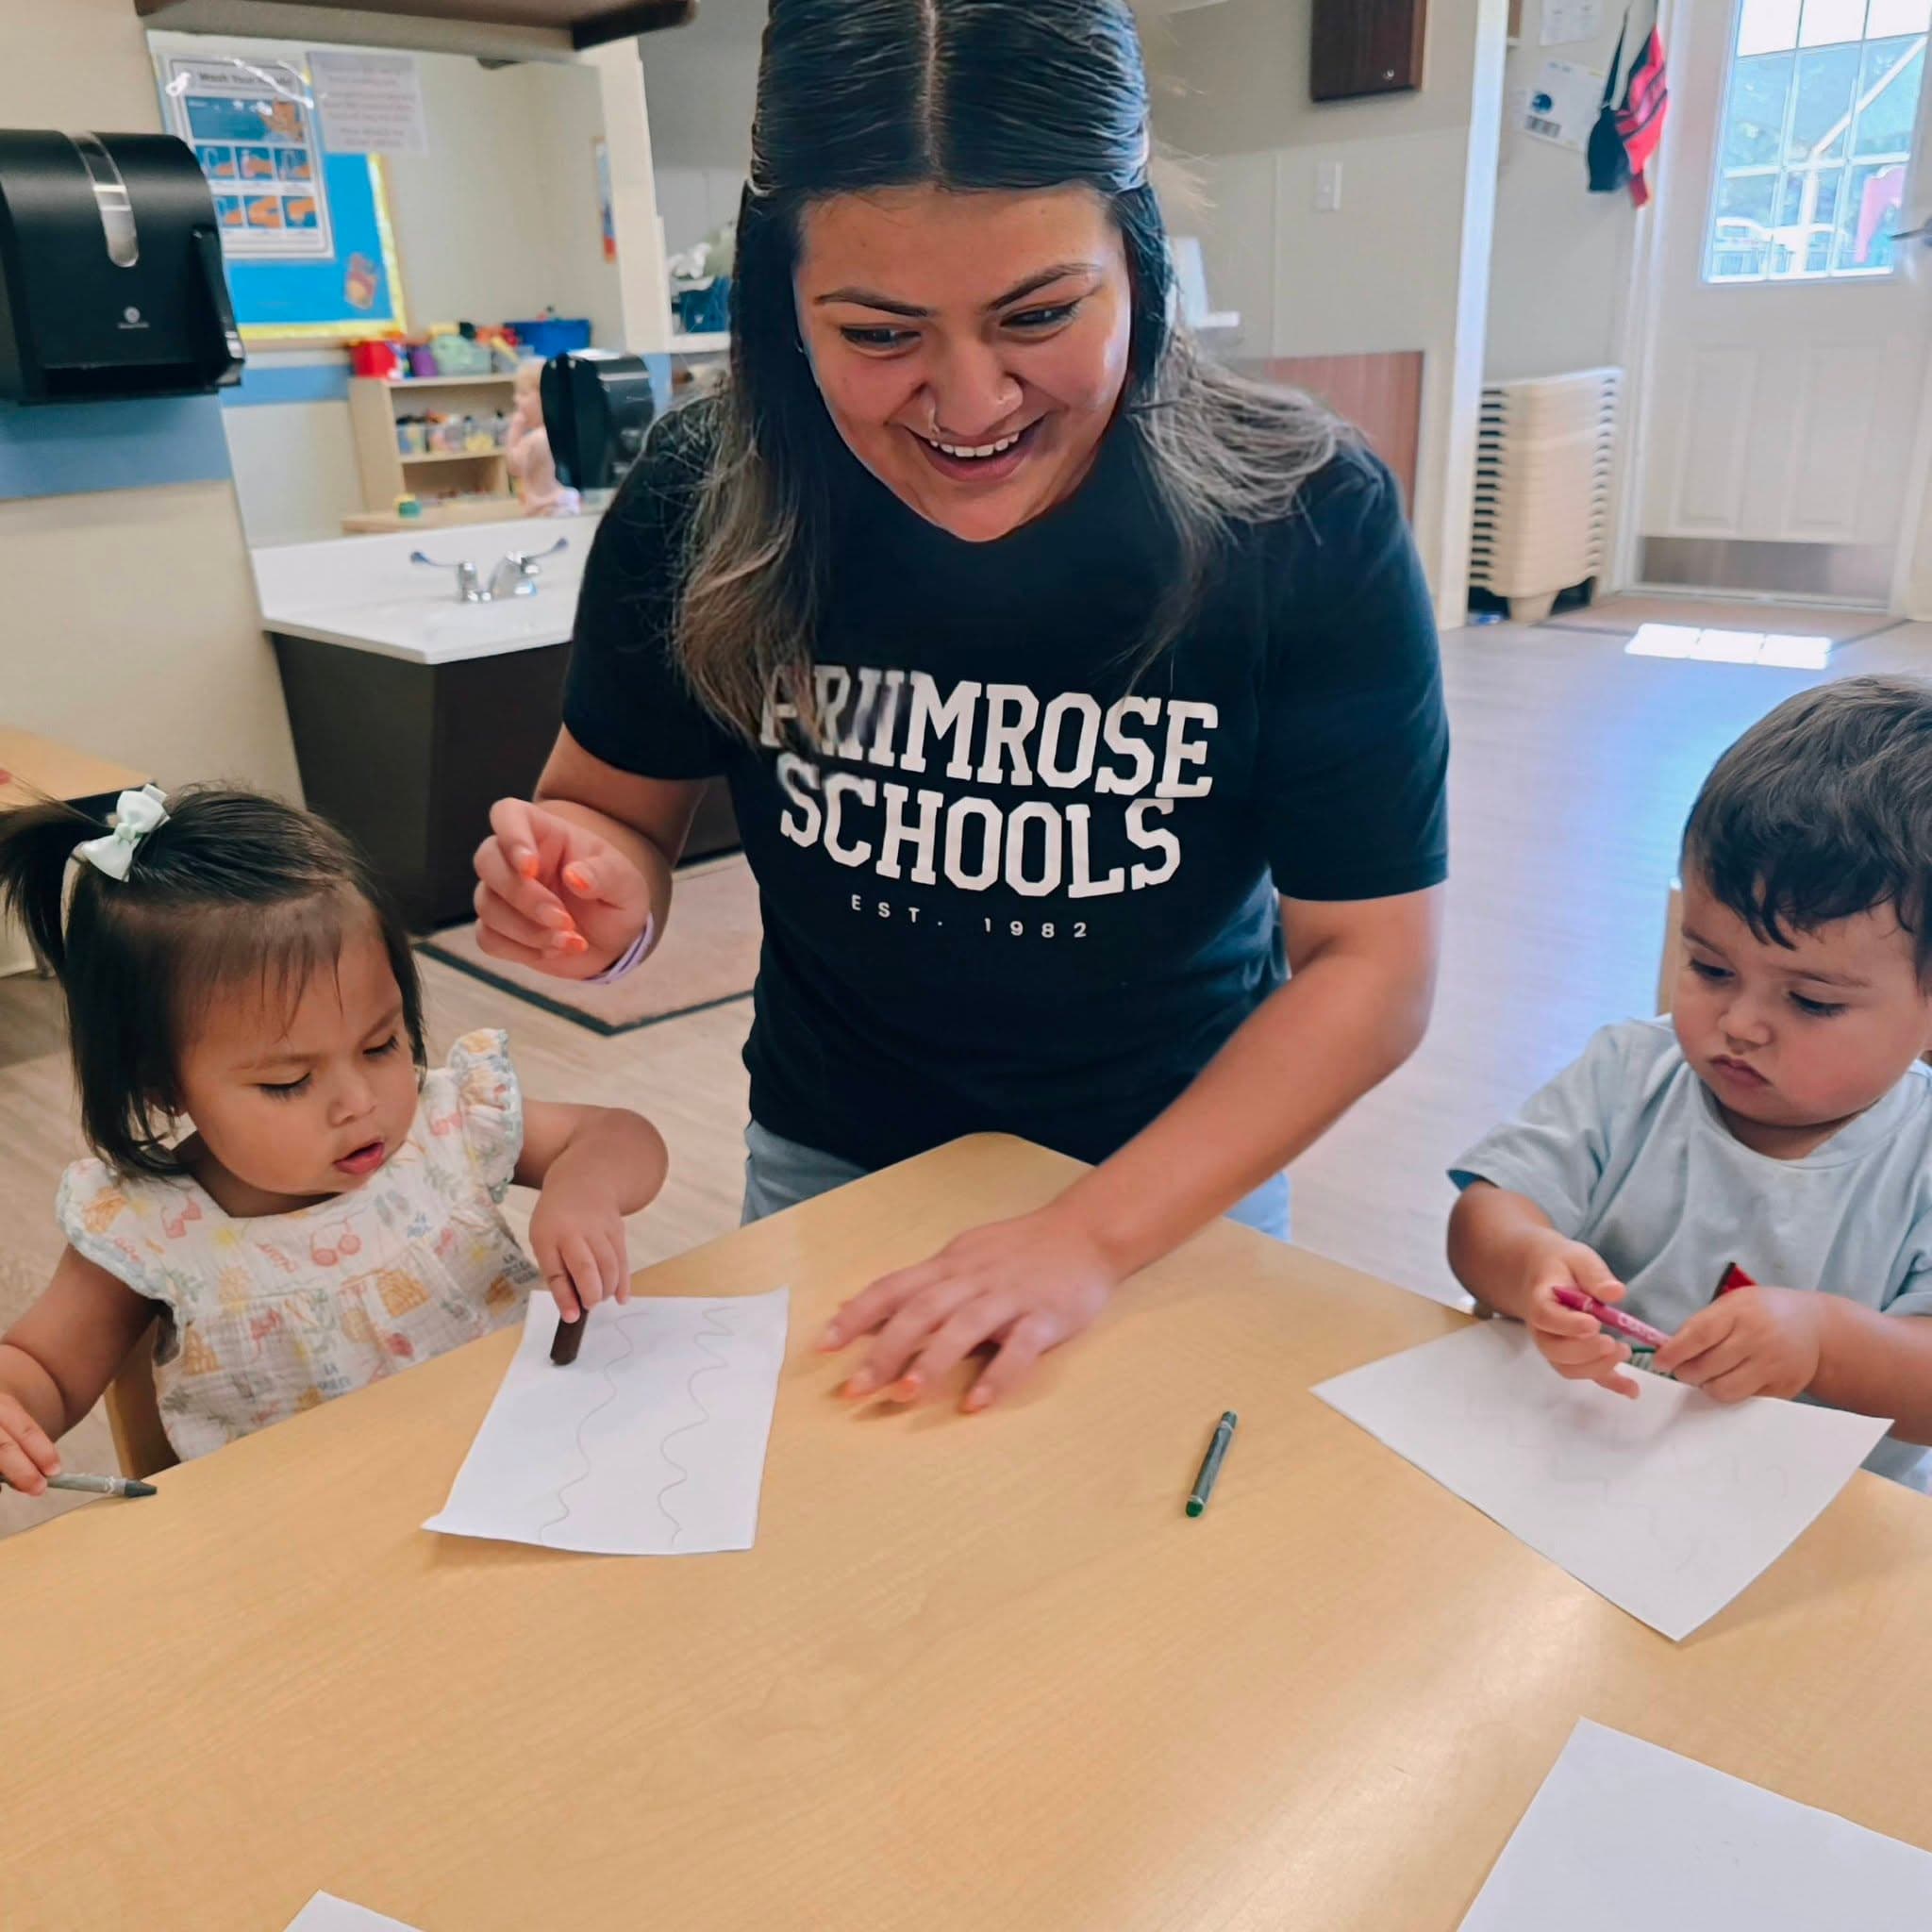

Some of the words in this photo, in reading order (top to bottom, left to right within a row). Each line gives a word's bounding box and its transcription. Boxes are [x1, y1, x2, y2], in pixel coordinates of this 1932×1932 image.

[777, 752, 1181, 898] SCHOOLS
[851, 893, 943, 927] EST.
[984, 917, 1089, 939] 1982
